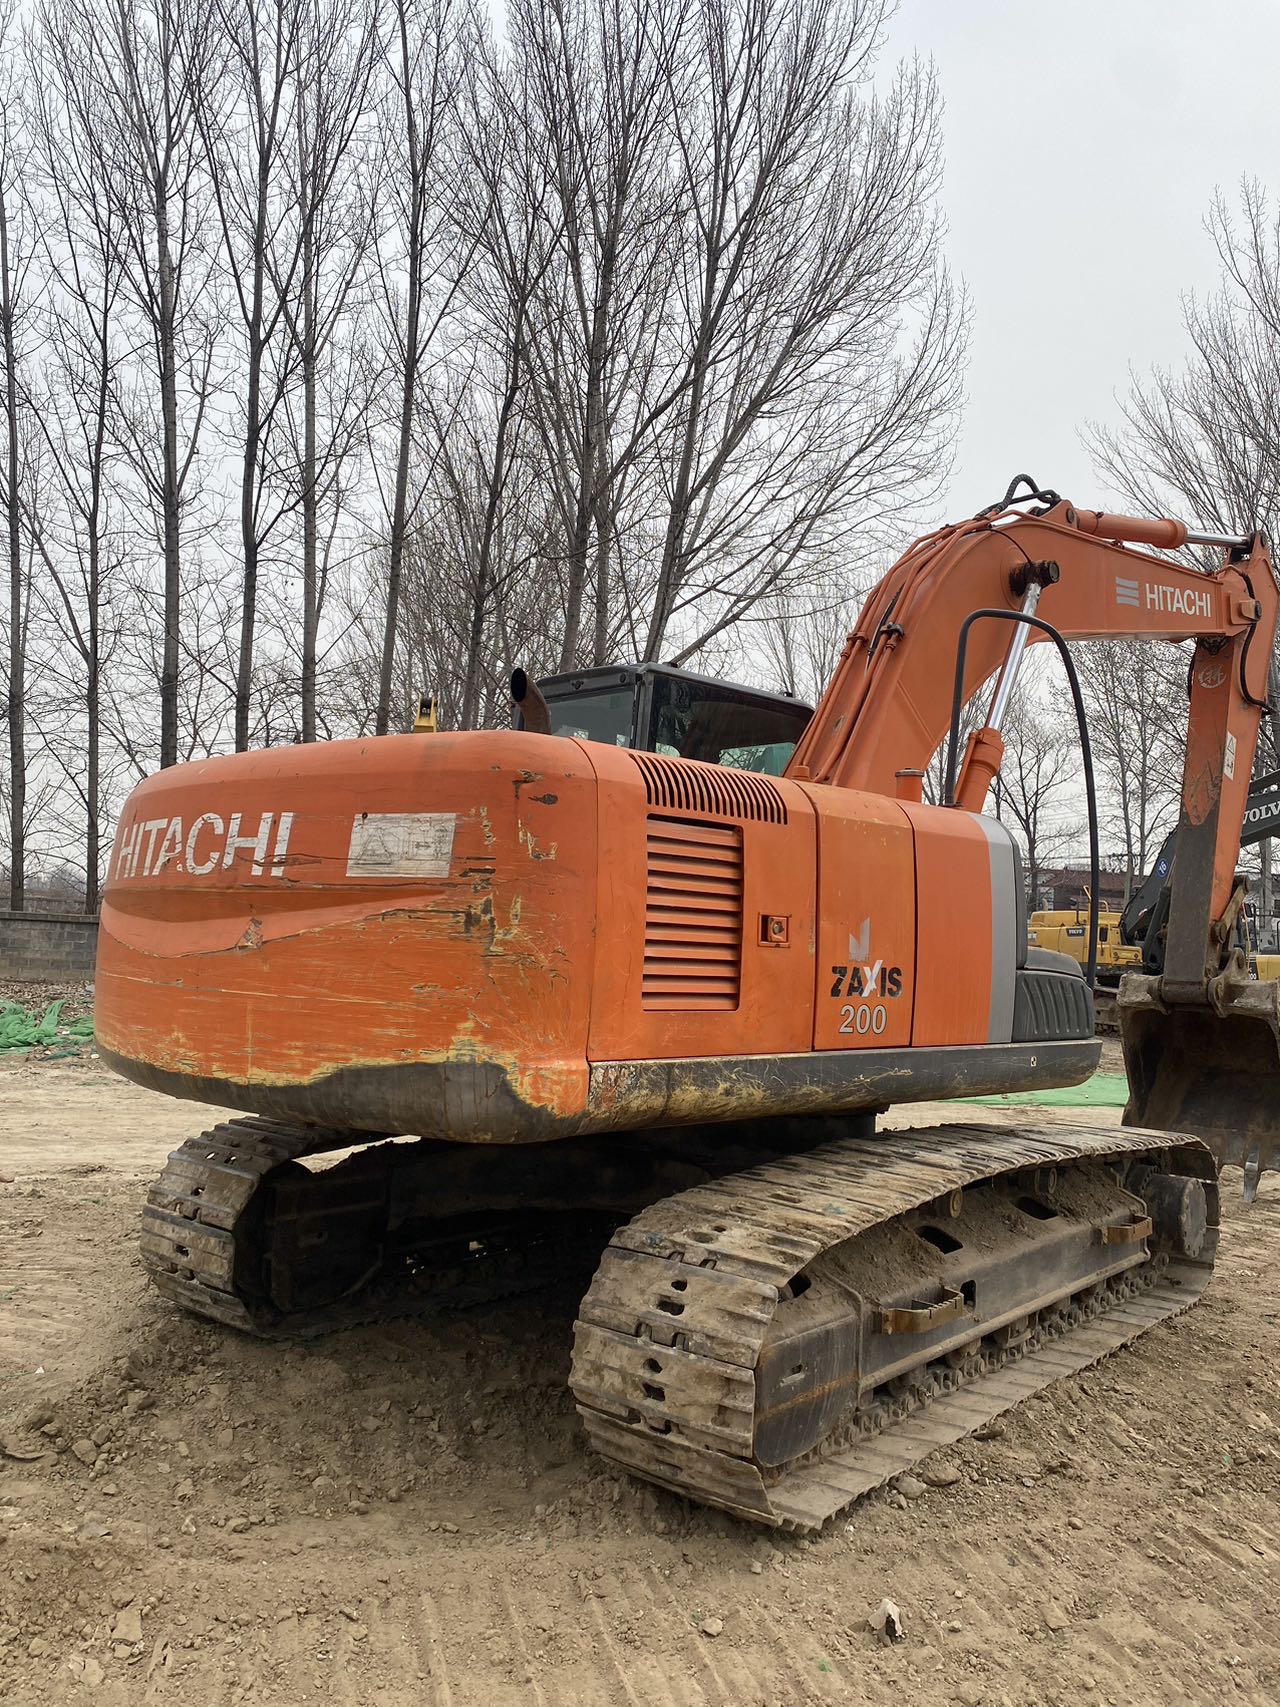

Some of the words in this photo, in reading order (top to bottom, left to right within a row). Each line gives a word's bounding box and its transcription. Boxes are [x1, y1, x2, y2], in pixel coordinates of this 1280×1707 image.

[1145, 583, 1212, 618] HITACHI
[115, 811, 295, 880] HITACHI
[830, 959, 903, 998] ZAXIS
[839, 1003, 887, 1035] 200
